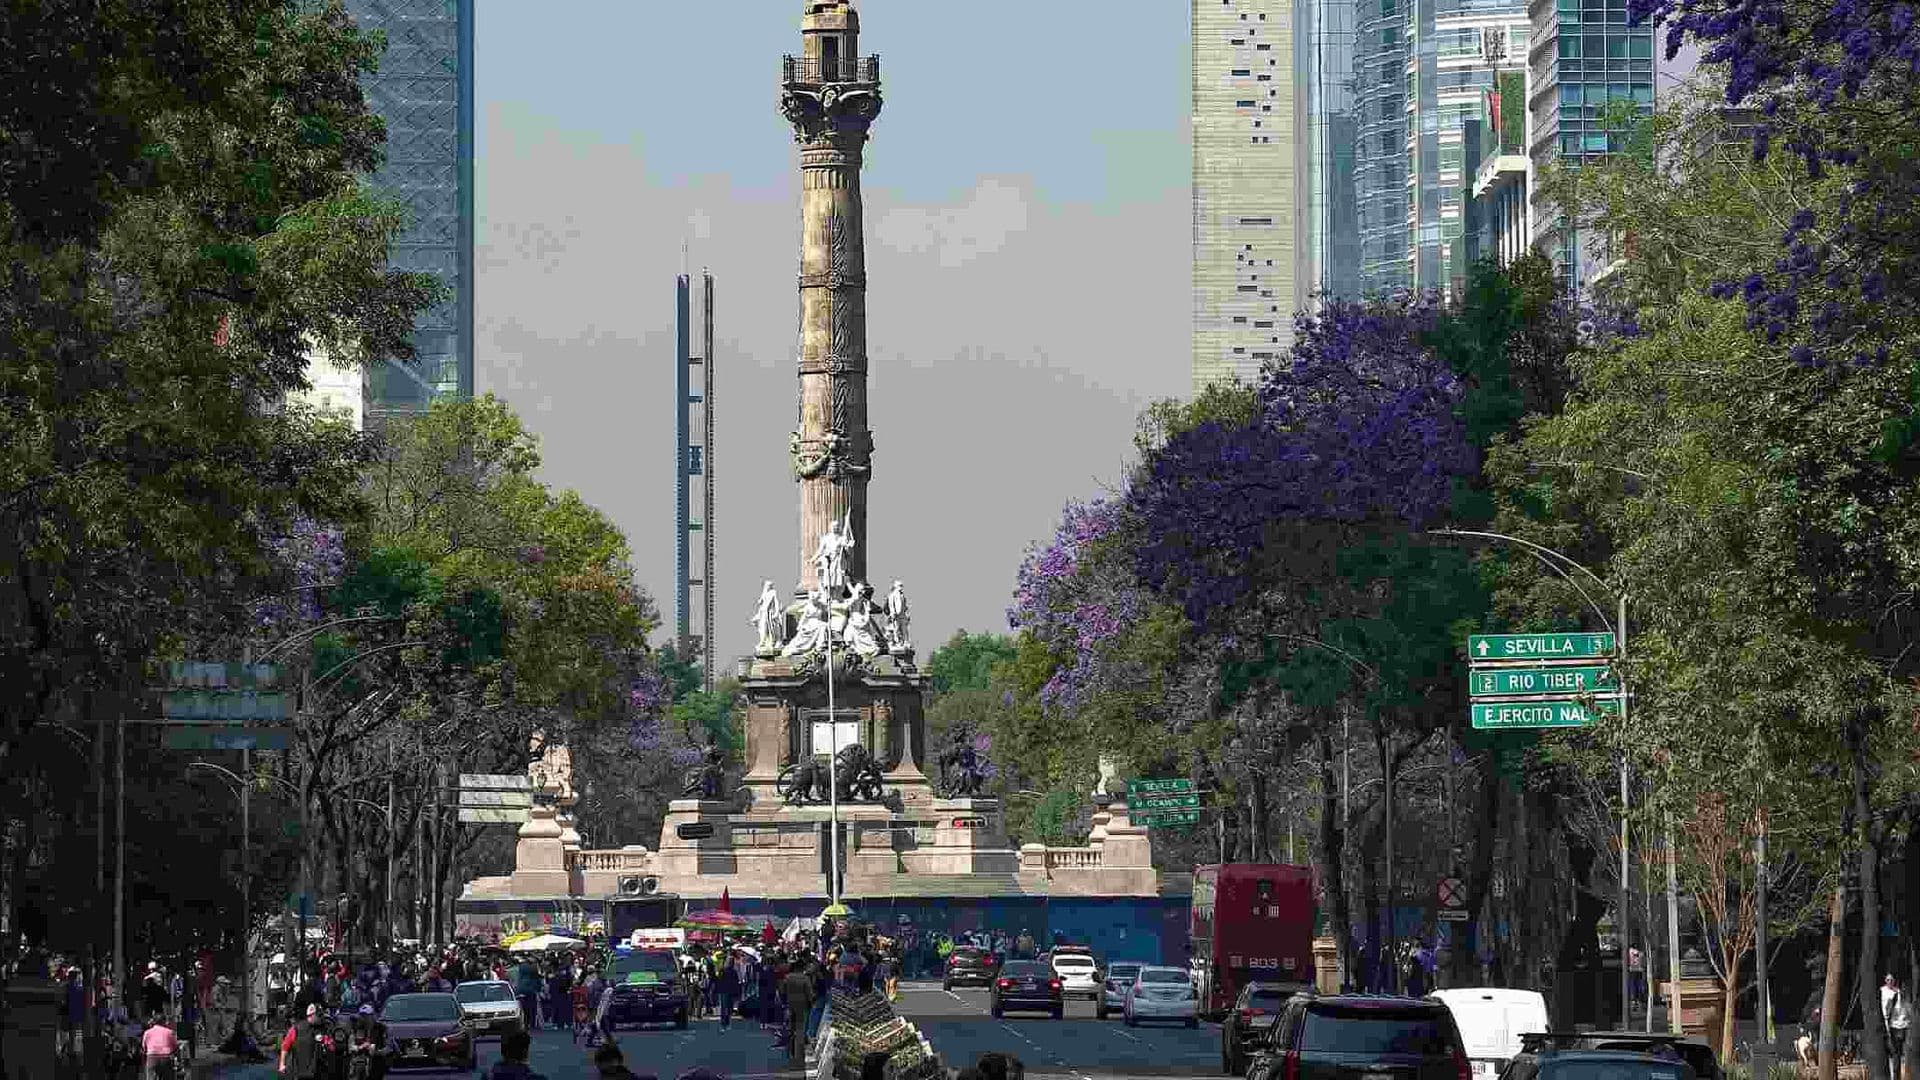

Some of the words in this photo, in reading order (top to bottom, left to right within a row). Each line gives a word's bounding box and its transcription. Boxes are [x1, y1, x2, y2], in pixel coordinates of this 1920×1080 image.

[1505, 639, 1575, 654] SEVILLA
[1509, 674, 1534, 689] RIO
[1542, 672, 1584, 688] TIBER
[1485, 708, 1552, 723] EJERCITO
